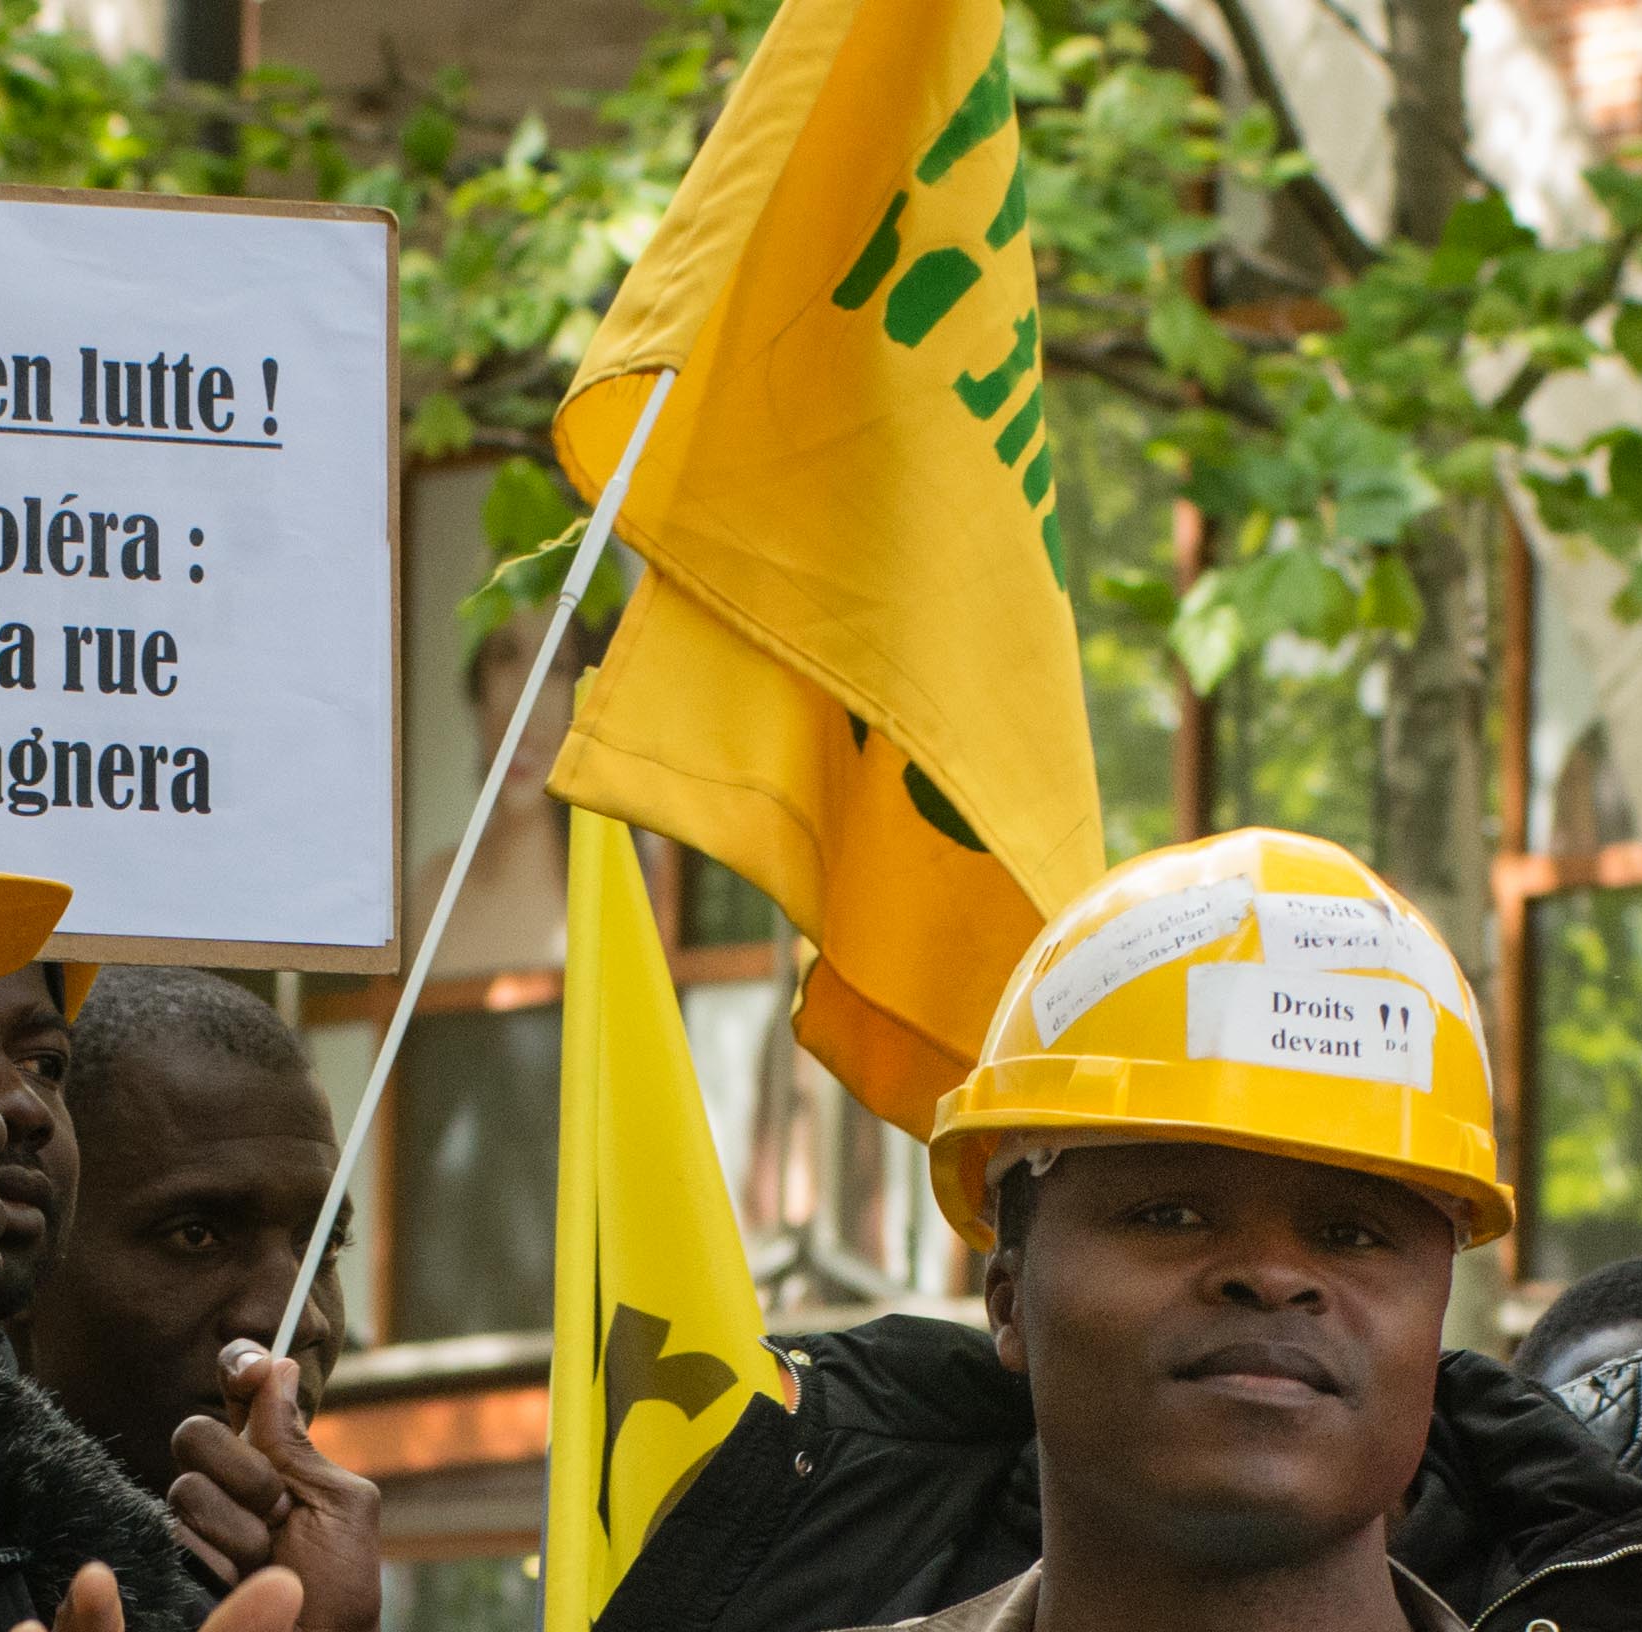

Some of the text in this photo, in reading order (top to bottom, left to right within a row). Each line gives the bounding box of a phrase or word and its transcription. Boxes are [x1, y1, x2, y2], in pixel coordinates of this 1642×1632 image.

[79, 347, 235, 433] lutte
[62, 626, 178, 697] rue
[1272, 991, 1355, 1022] Droits
[1271, 1028, 1363, 1058] devant
